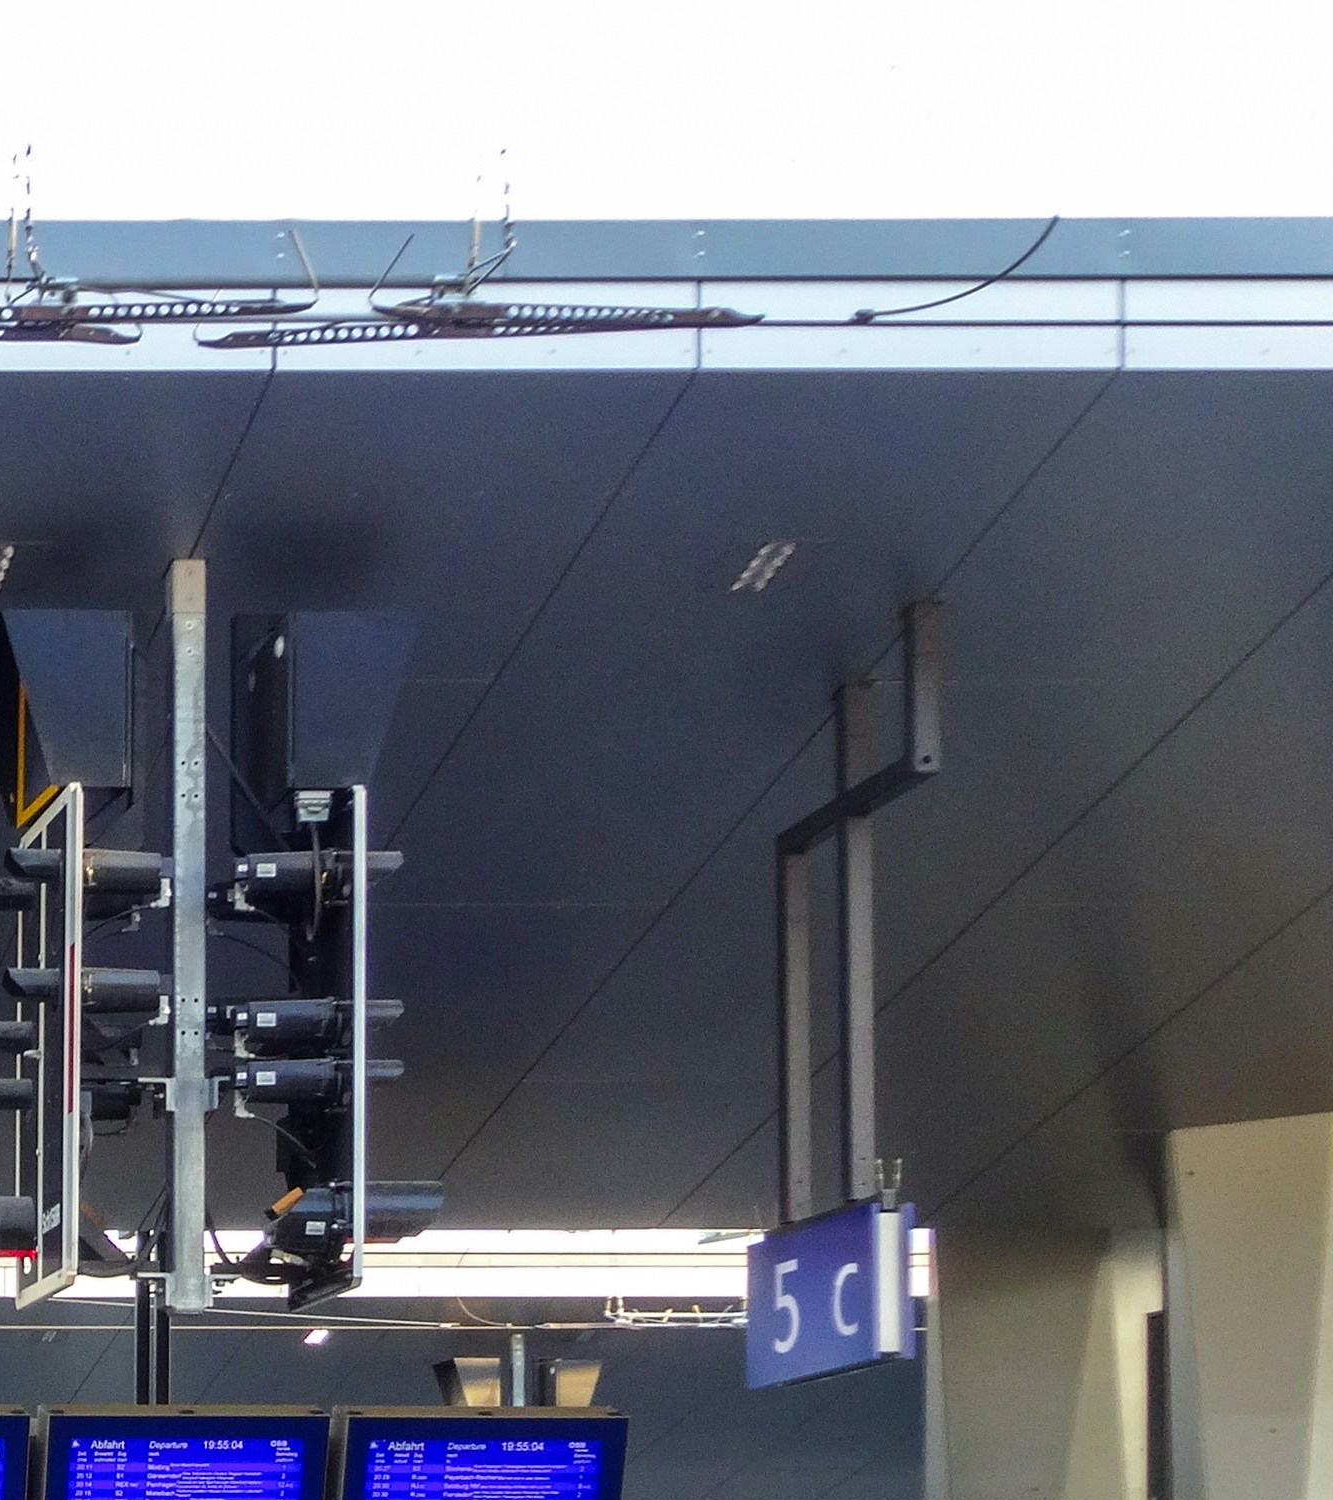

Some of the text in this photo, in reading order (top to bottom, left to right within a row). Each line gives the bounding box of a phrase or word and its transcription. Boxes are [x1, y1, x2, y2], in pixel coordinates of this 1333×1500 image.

[773, 1258, 800, 1354] 5
[90, 1439, 125, 1450] Abfahrt
[149, 1440, 189, 1451] Departure
[203, 1440, 244, 1450] 19:55:04
[387, 1441, 425, 1451] Abfahrt
[447, 1442, 487, 1451] Departure
[502, 1442, 544, 1451] 19:55:04
